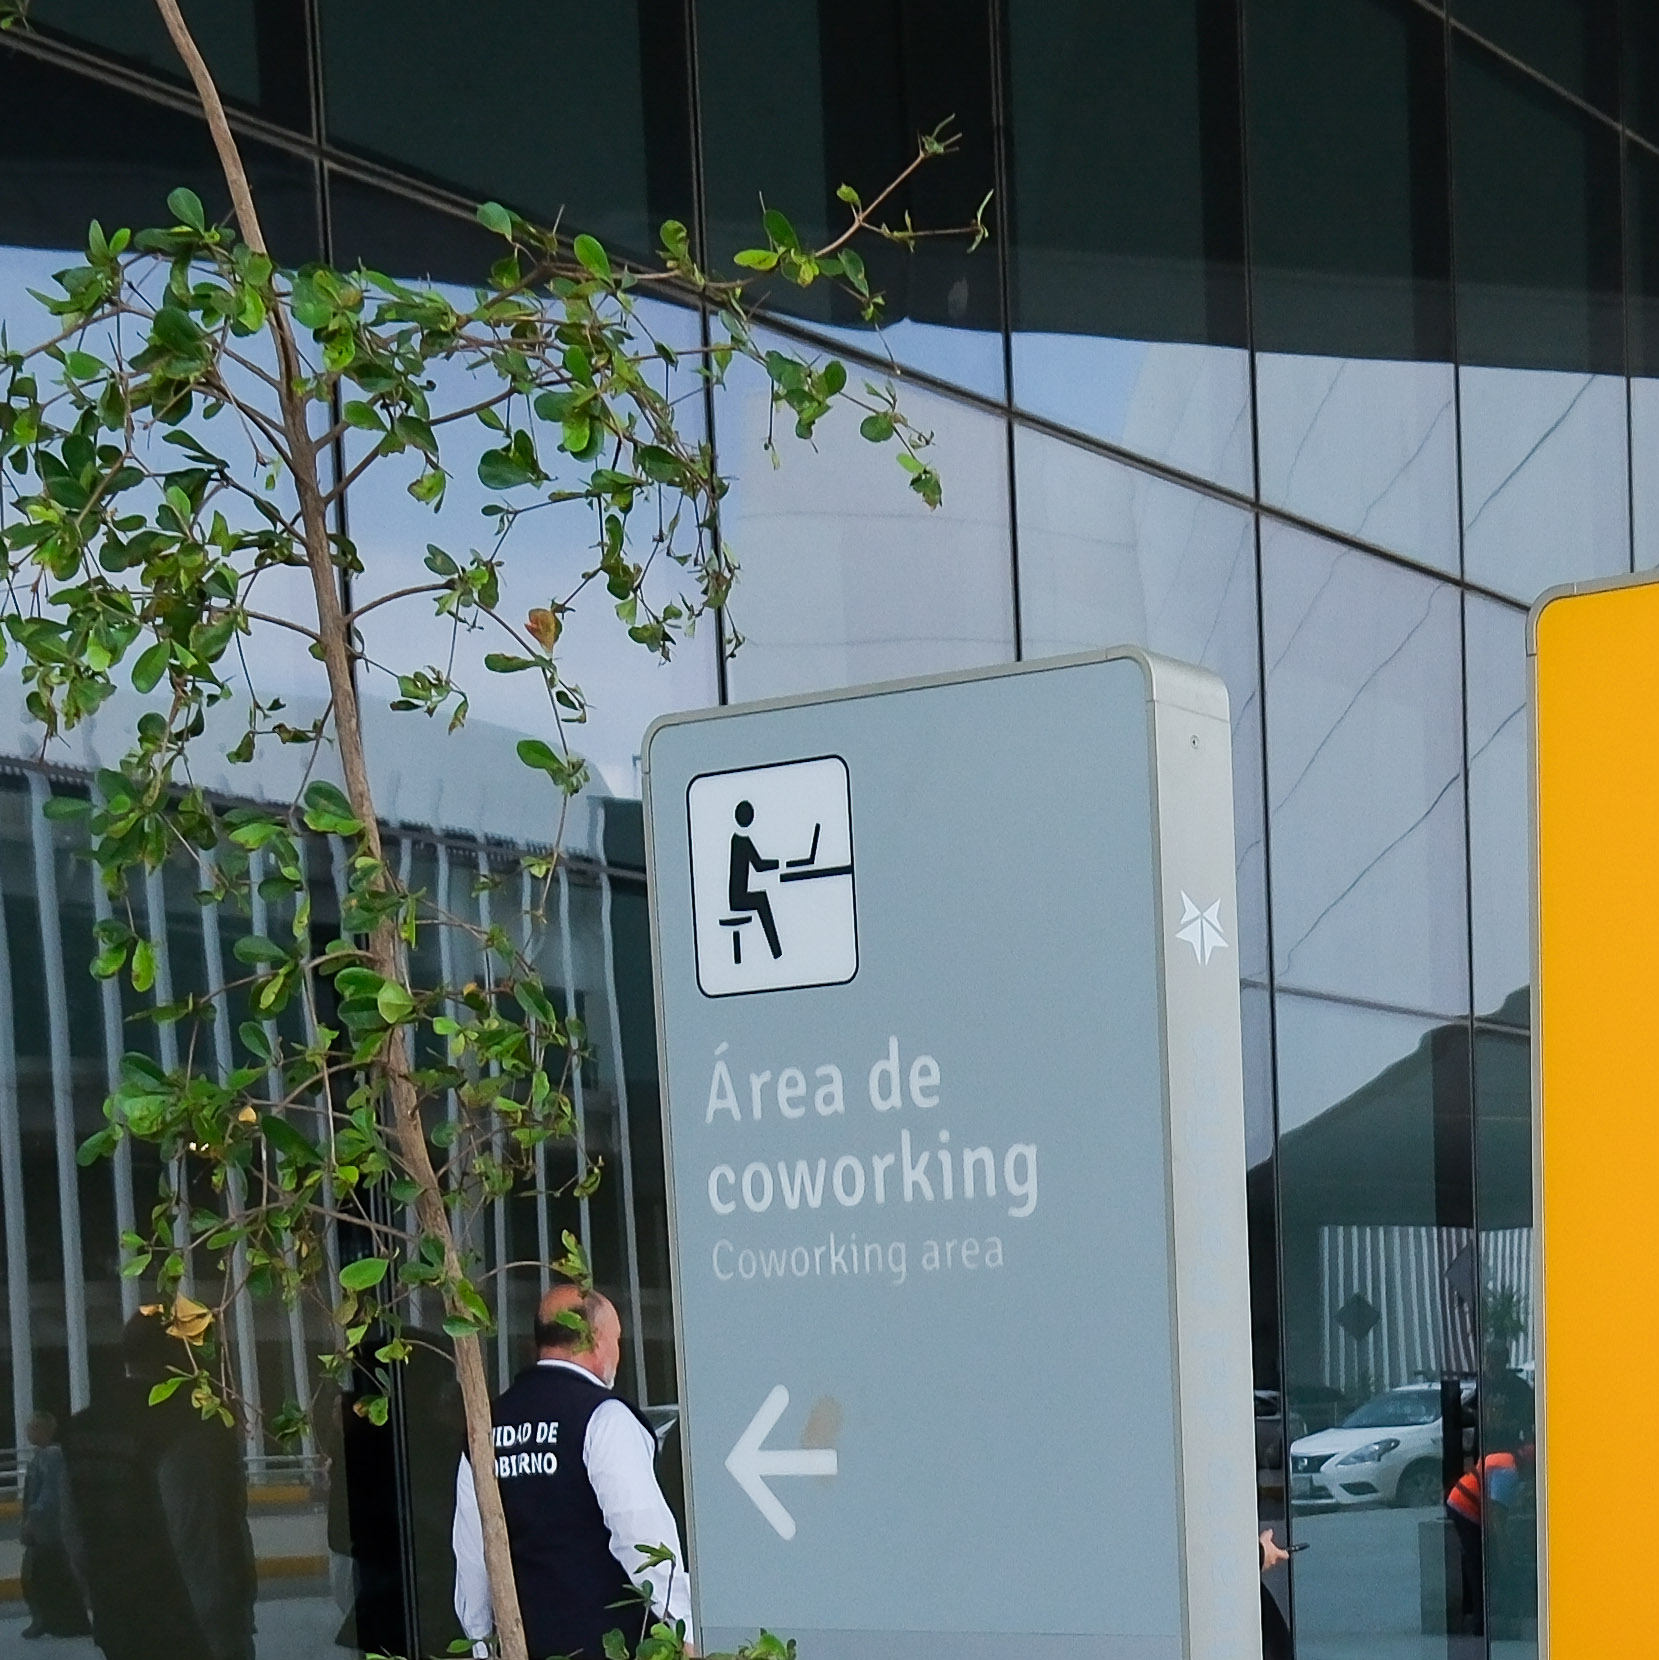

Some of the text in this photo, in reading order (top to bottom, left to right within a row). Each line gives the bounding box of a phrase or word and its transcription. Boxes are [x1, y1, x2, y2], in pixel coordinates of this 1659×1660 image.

[704, 1035, 941, 1124] Área de
[707, 1128, 1038, 1218] coworking
[712, 1231, 1004, 1285] Coworking area
[536, 1421, 559, 1444] DE
